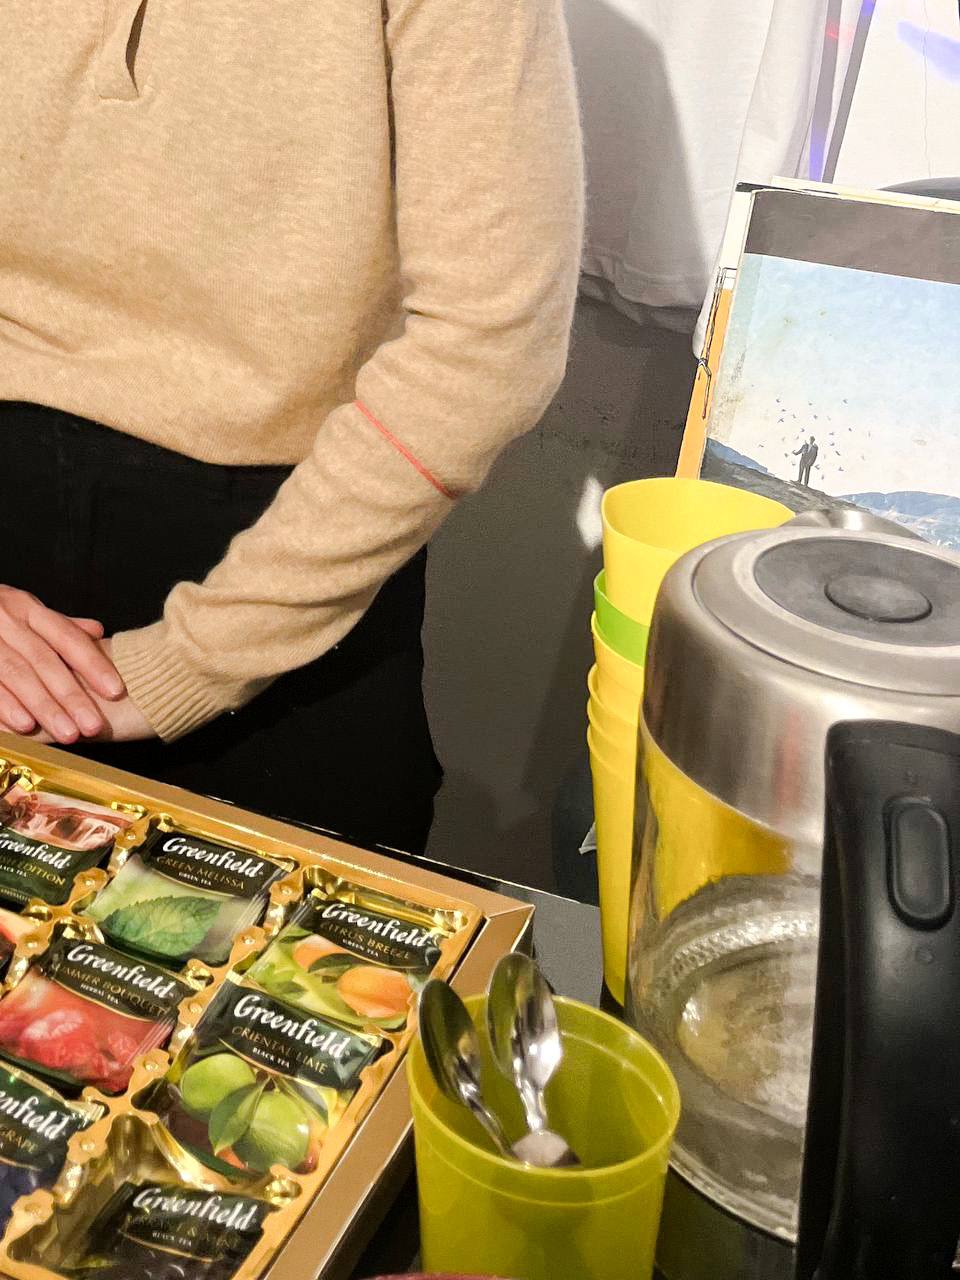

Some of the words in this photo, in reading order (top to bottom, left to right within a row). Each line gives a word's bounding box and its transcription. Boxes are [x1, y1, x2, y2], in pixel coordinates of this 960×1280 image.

[157, 856, 194, 872] GREEN
[196, 867, 244, 890] MELISSA
[162, 837, 264, 878] Greenfield
[322, 903, 431, 947] Greenfield
[67, 944, 177, 998] Greenfield
[233, 994, 351, 1058] Greenfield
[232, 1026, 294, 1056] ORIENTAL
[296, 1052, 328, 1074] LIME
[252, 1047, 275, 1061] BLACK
[277, 1057, 290, 1068] TEA
[132, 1187, 258, 1231] Greenfield
